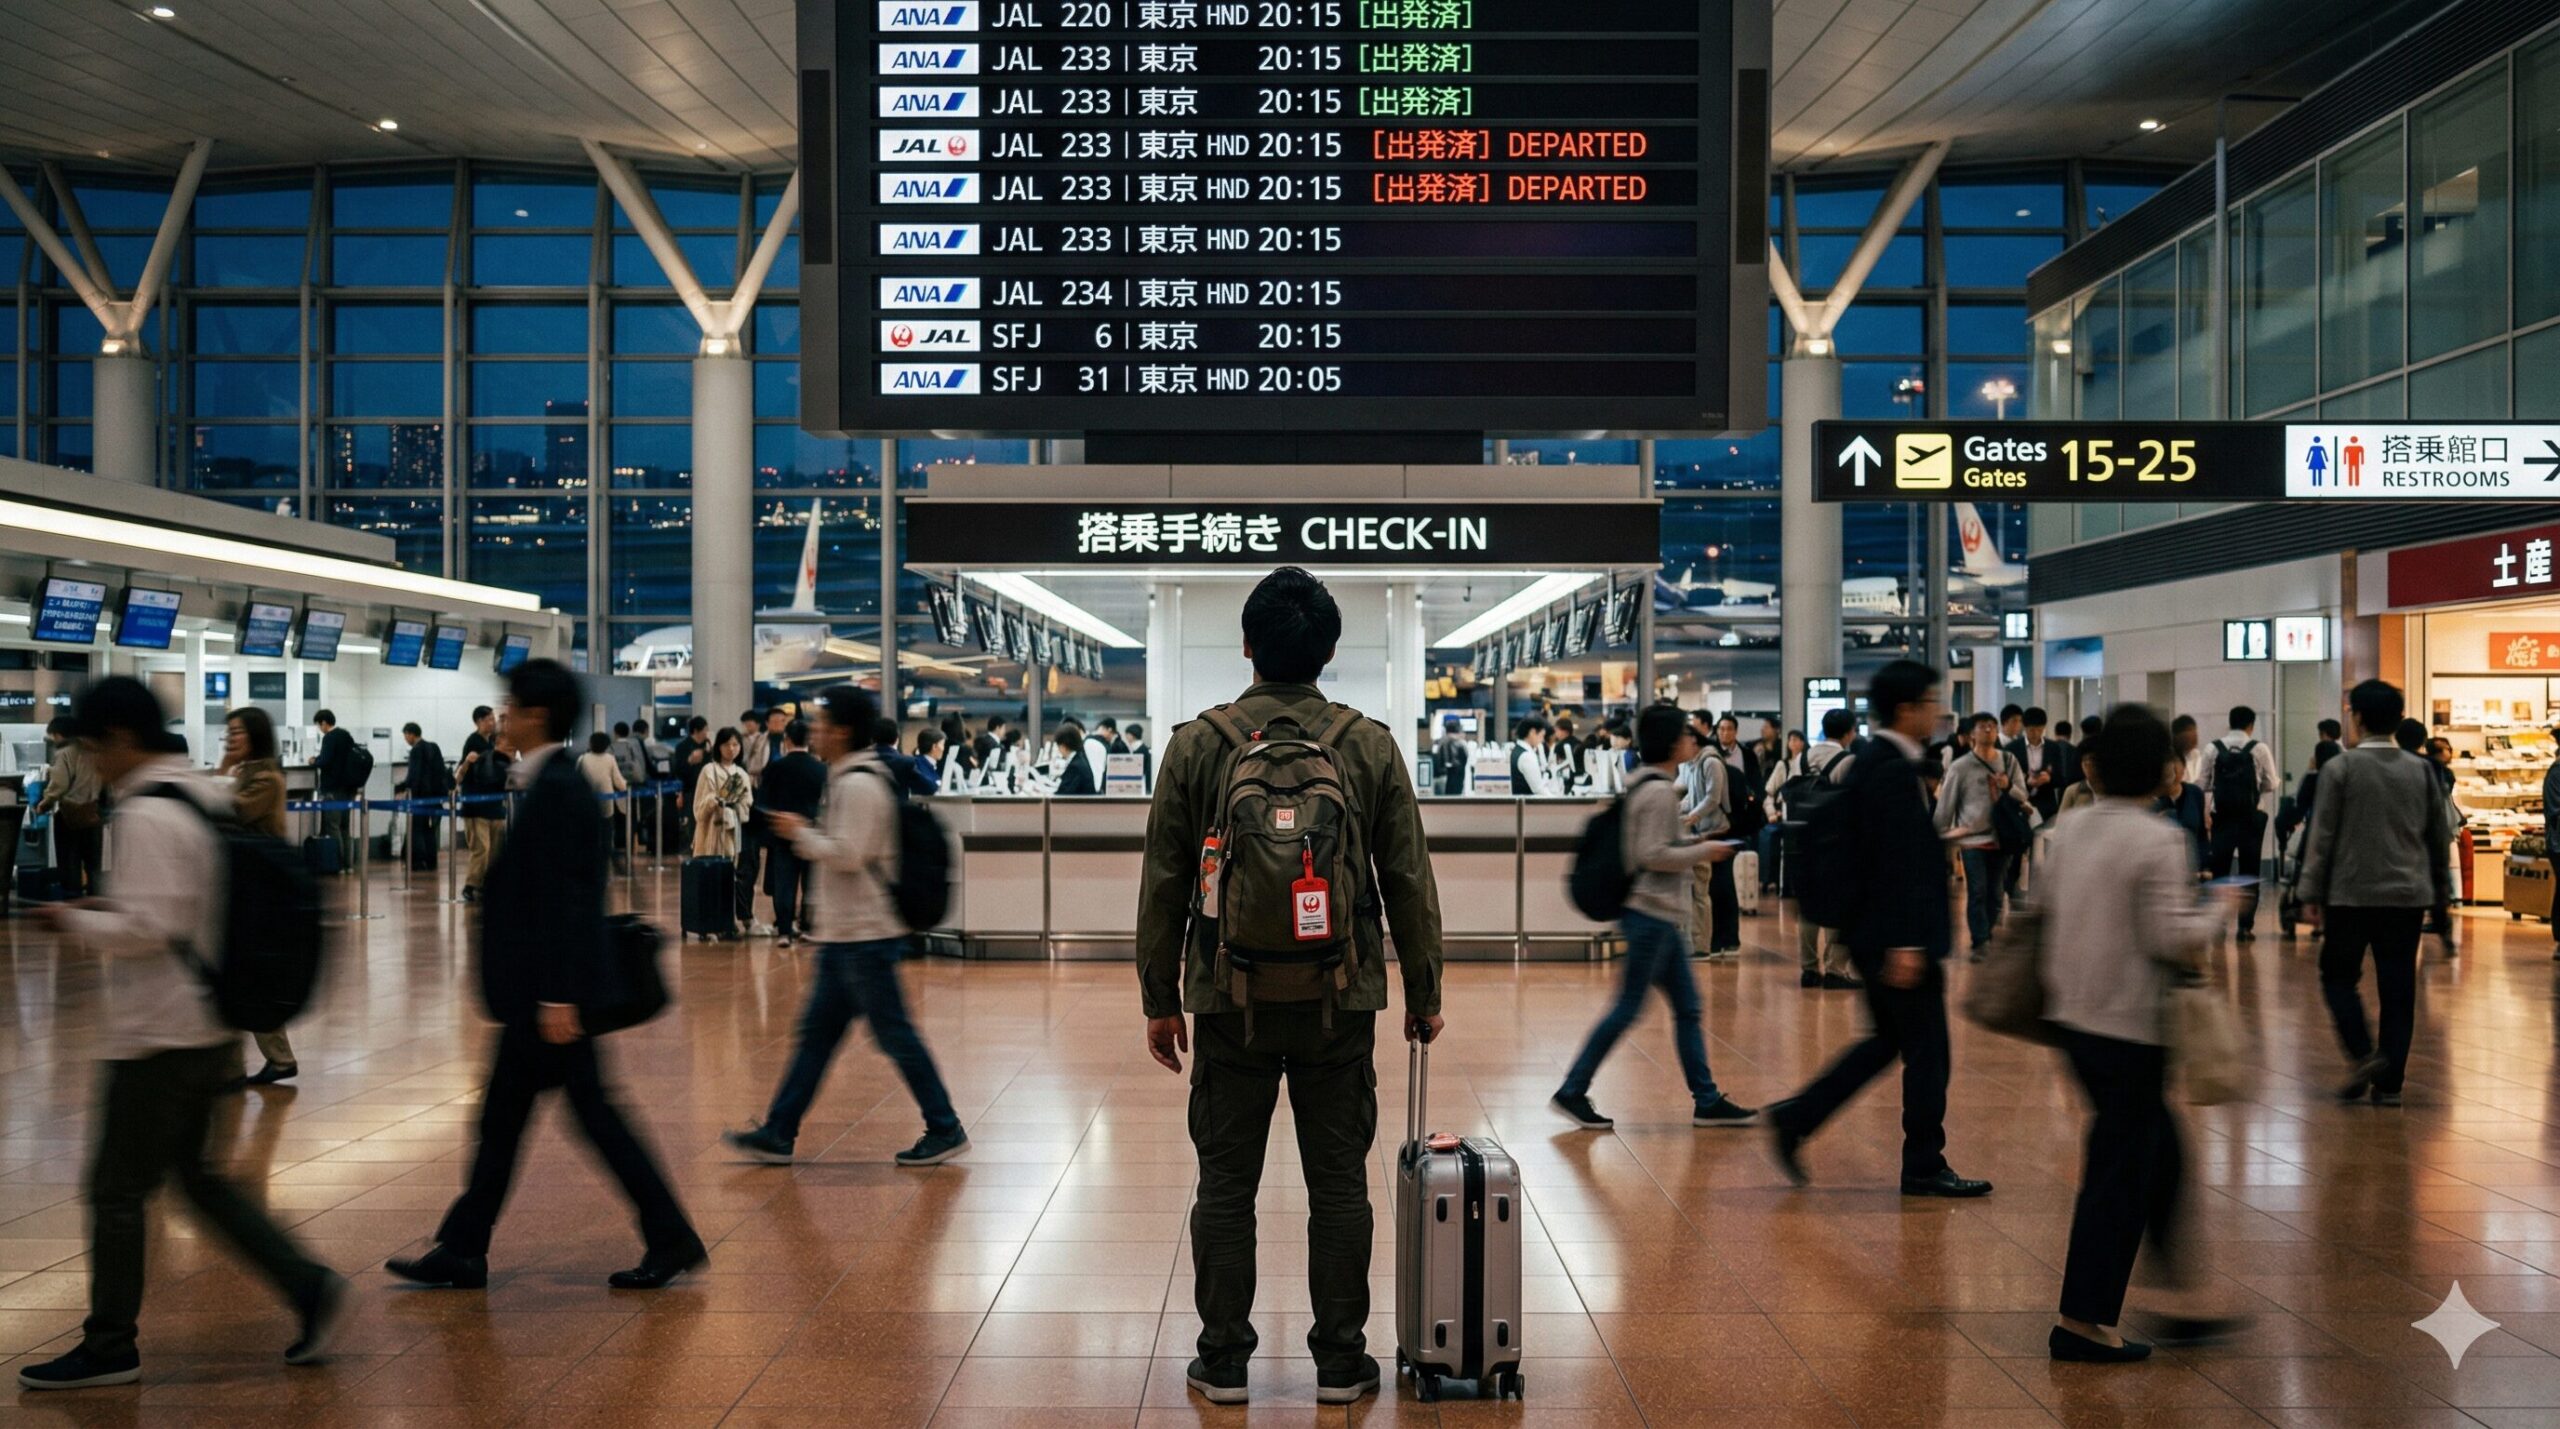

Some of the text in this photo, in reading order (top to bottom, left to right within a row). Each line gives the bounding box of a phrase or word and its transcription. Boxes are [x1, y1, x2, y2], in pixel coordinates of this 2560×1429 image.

[891, 0, 1471, 29] ANA JAL 220 東京 HND 20:15 [出発済]
[892, 43, 1471, 72] ANA JAL 233 東京 20:15 [出発済]
[892, 87, 1471, 115] ANA JAL 233 東京 20:15 [出発済]
[893, 130, 1646, 159] JAL JAL 233 東京 HND 20:15 [出発済] DEPARTED
[893, 173, 1646, 202] ANA JAL 233 東京 HND 20:15 [出発済] DEPARTED
[893, 225, 1341, 253] ANA JAL 233 東京 HND 20:15
[894, 278, 1341, 307] ANA JAL 234 東京 HND 20:15
[920, 321, 1341, 350] JAL SFJ 6 東京 20:15
[894, 364, 1341, 393] ANA SFJ 31 東京 HND 20:05
[1964, 436, 2196, 481] Gates 15-25
[1964, 468, 2026, 487] Gates
[2383, 471, 2509, 487] RESTROOMS
[1078, 512, 1486, 553] 搭乗手続き CHECK-IN
[2493, 539, 2551, 587] 土産
